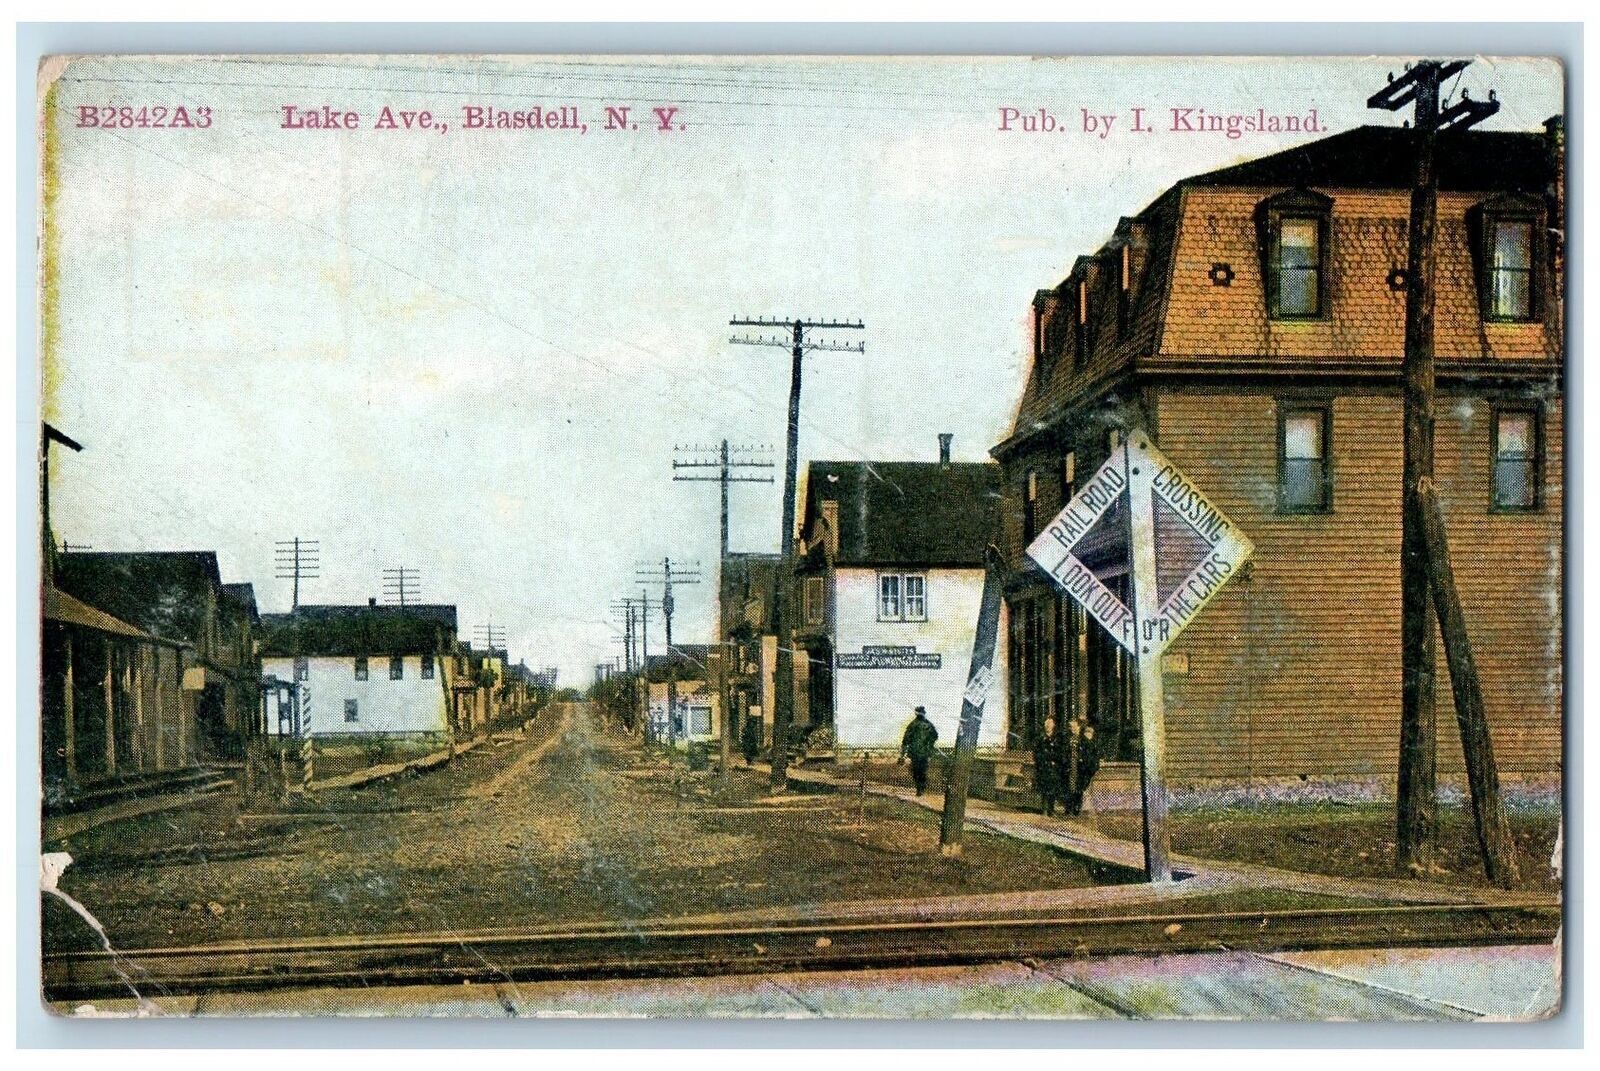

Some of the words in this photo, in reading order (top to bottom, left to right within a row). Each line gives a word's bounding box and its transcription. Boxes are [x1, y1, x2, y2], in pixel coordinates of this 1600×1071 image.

[1050, 509, 1094, 549] RAIL
[1079, 465, 1125, 516] ROAD
[1152, 464, 1230, 543] CROSSING
[1050, 553, 1097, 605] LOOK
[1093, 590, 1131, 630] OUT
[1160, 588, 1194, 628] THE
[1187, 552, 1232, 601] CARS
